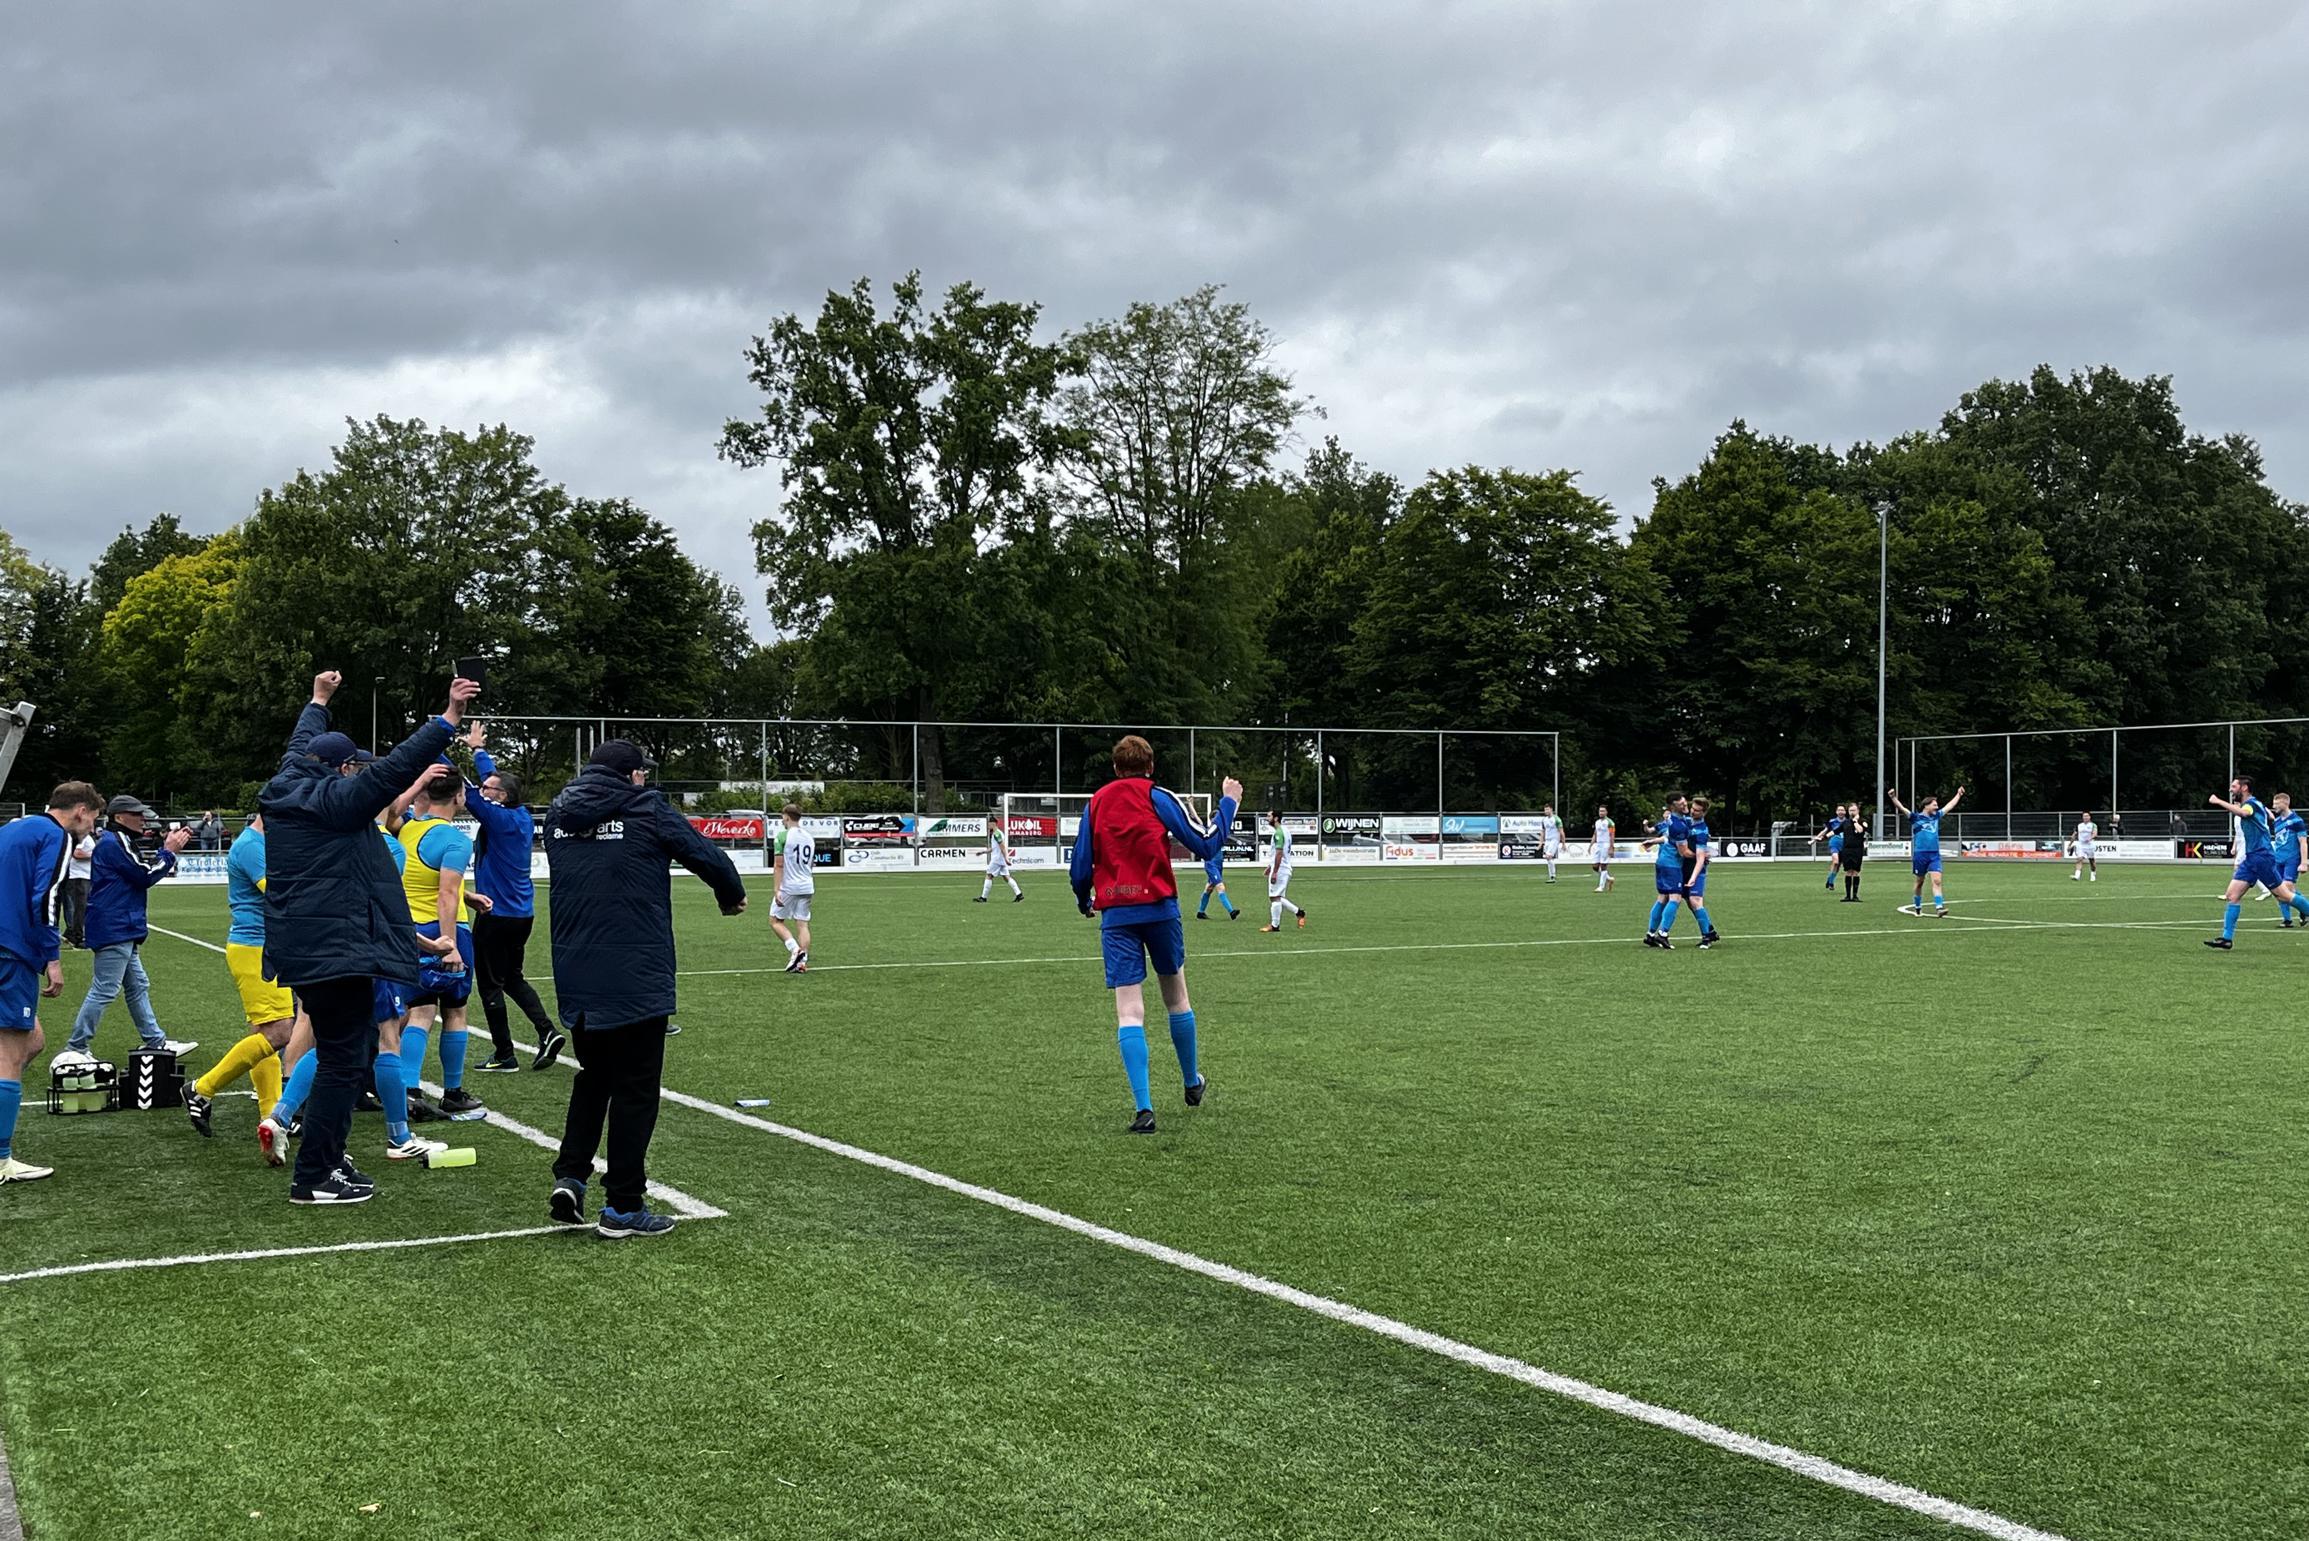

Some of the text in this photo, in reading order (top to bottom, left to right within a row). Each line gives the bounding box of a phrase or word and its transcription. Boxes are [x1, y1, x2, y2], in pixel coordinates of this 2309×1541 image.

[596, 819, 624, 834] arts
[1335, 818, 1379, 830] WIJNEN
[920, 849, 967, 858] CARMEN
[1740, 843, 1766, 853] GAAF
[793, 844, 811, 865] 19
